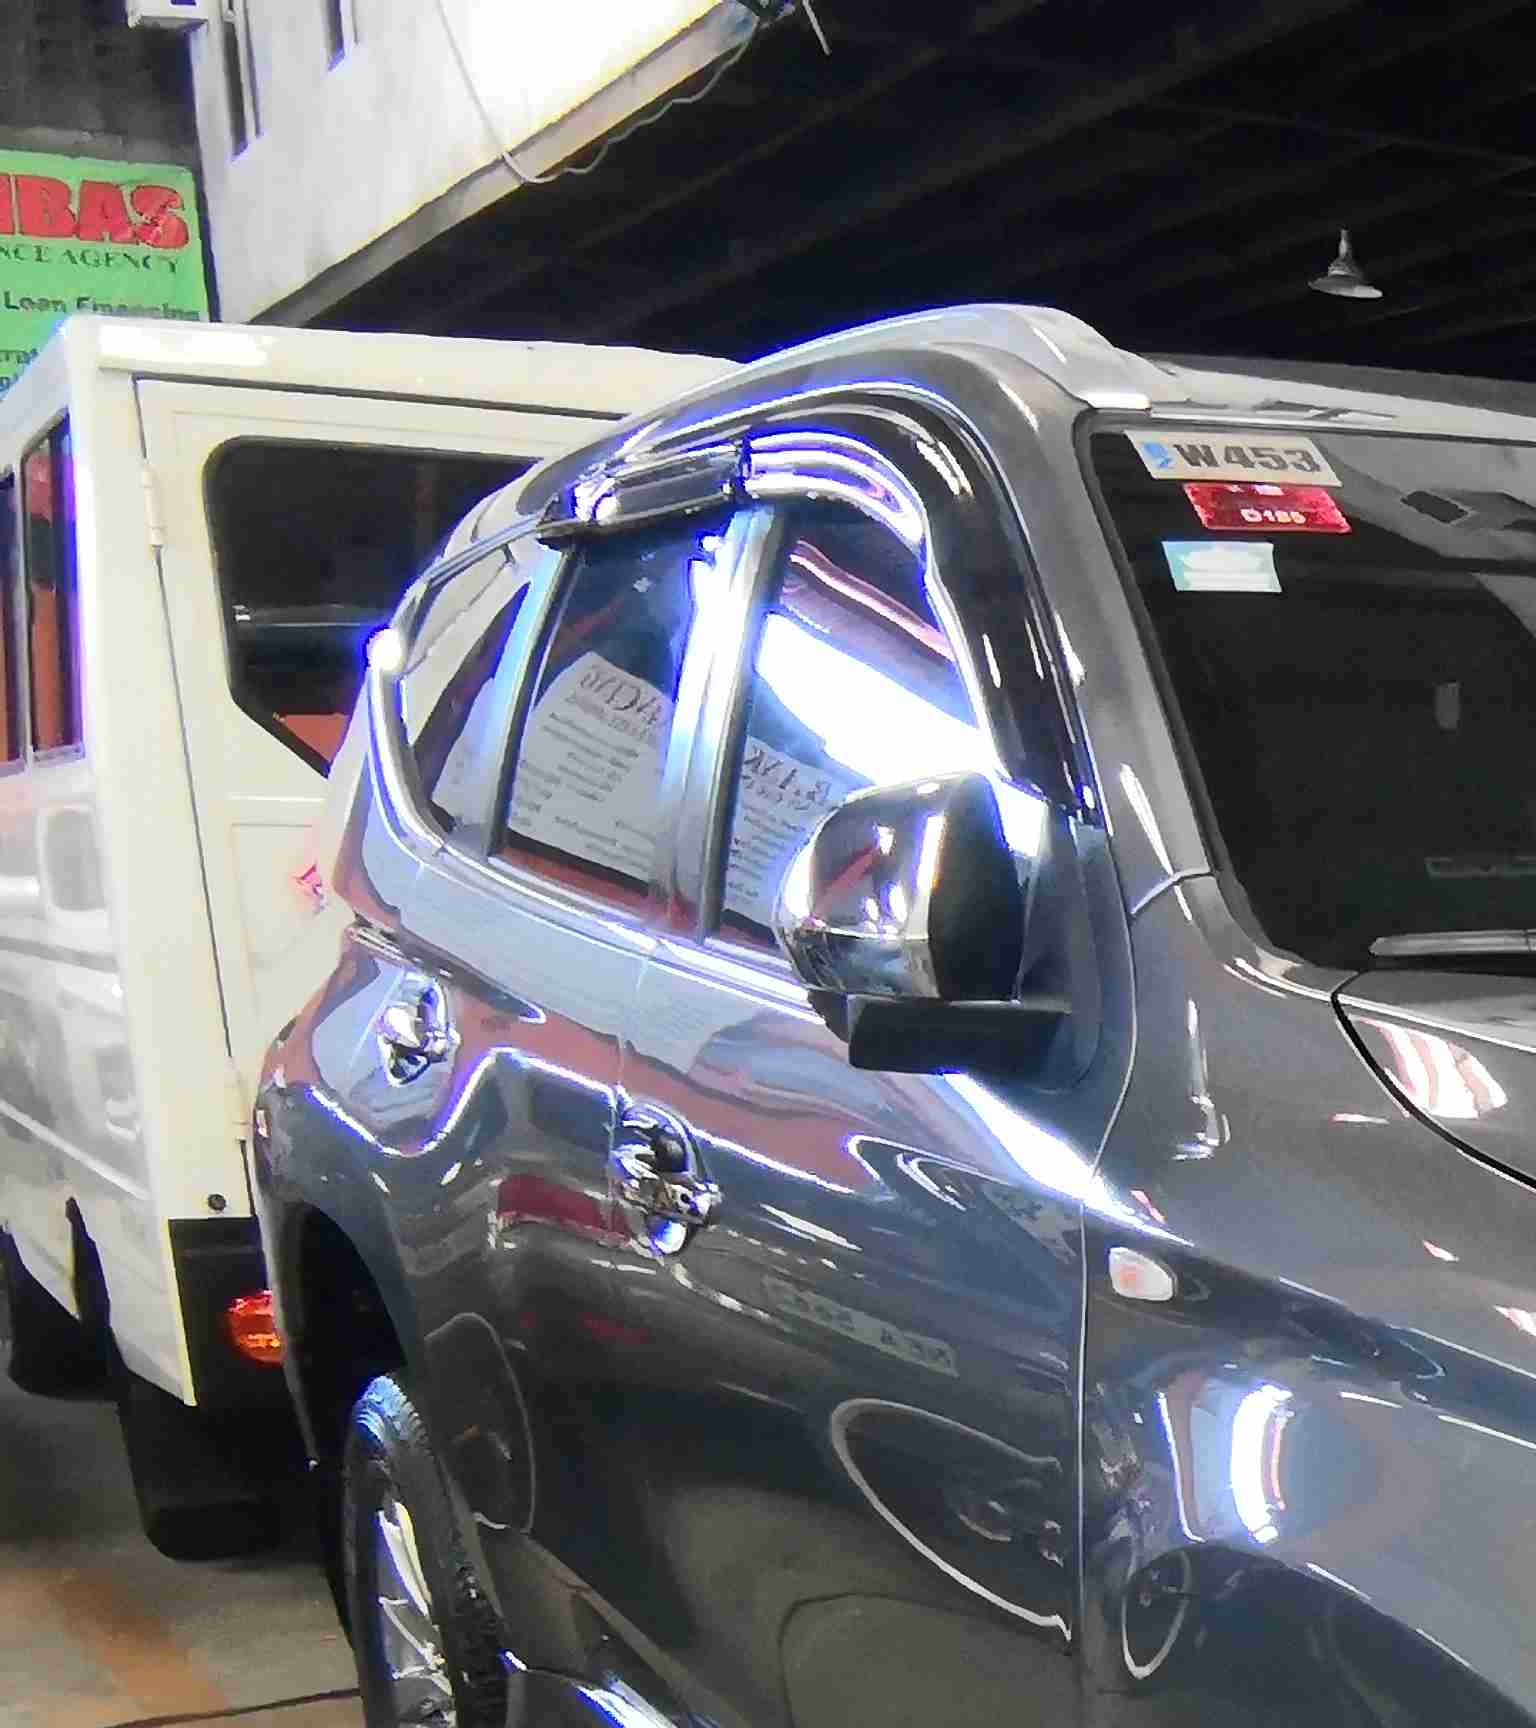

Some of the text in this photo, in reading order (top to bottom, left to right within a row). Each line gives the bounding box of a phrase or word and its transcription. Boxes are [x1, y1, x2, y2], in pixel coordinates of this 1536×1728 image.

[0, 173, 190, 250] BAS
[63, 249, 180, 275] AGENCY
[1172, 442, 1321, 473] W453
